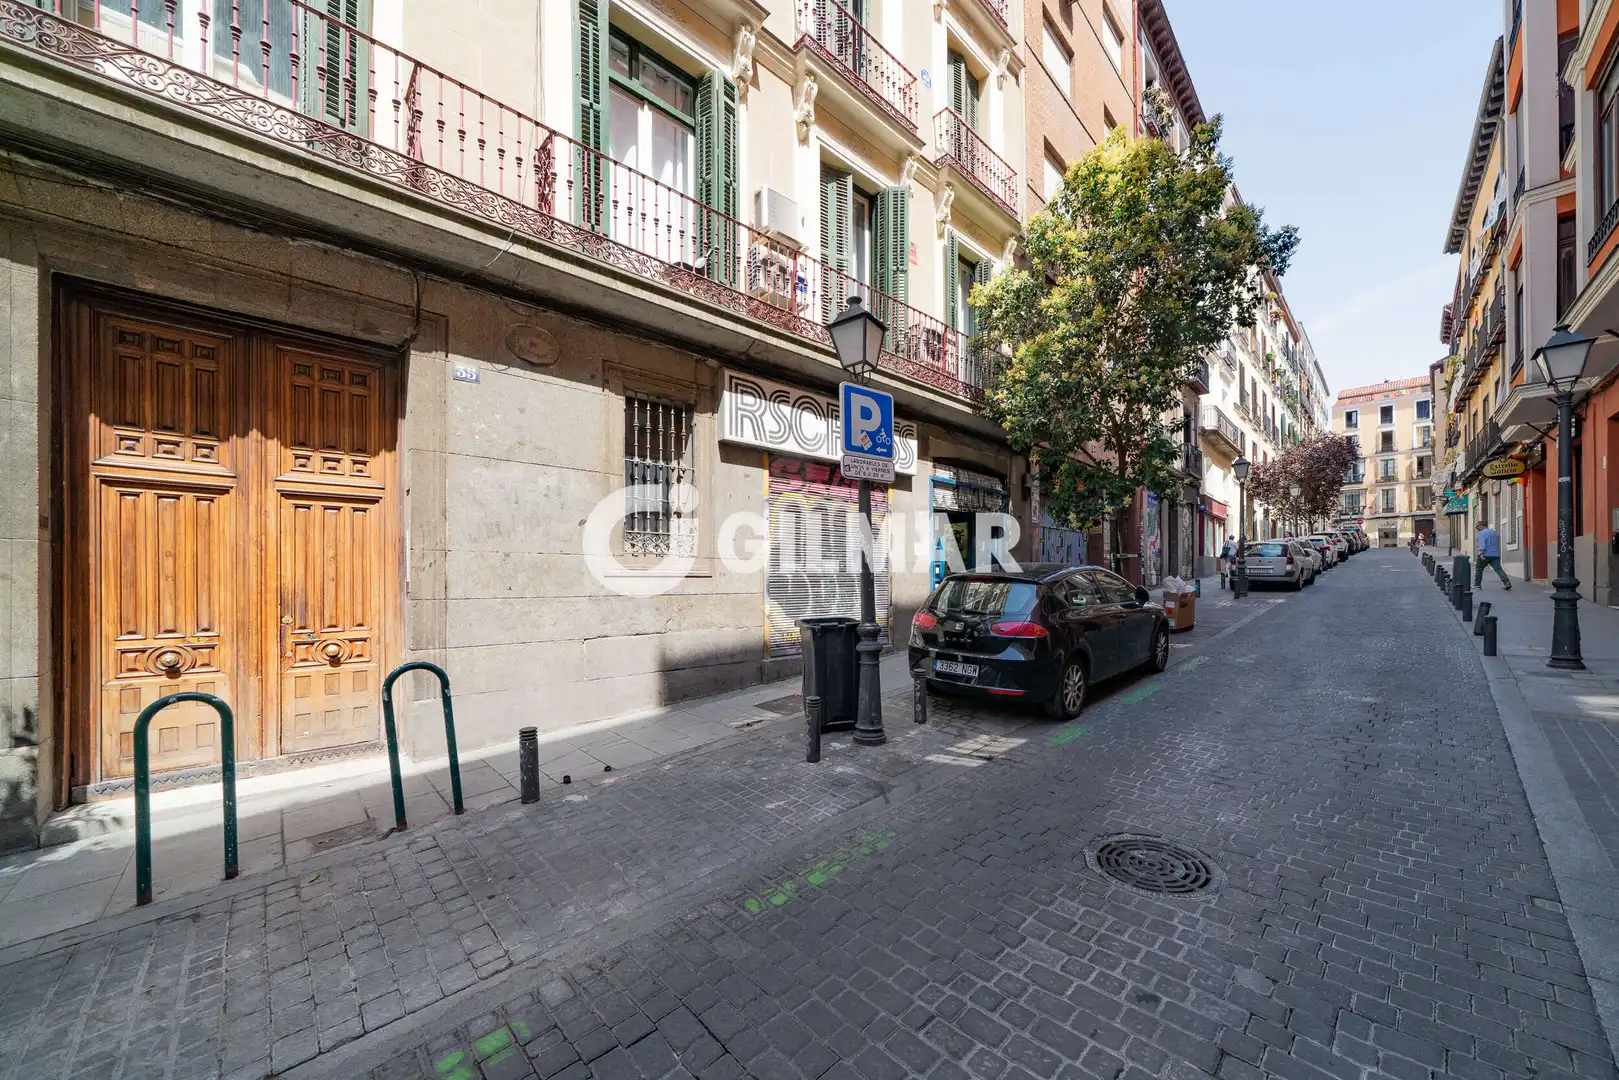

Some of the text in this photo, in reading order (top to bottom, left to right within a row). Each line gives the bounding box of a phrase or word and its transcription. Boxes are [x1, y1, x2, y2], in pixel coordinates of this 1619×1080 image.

[456, 367, 477, 380] 35
[850, 392, 882, 447] P
[850, 458, 880, 467] LABORABLES
[939, 661, 978, 676] 3362 NGW
